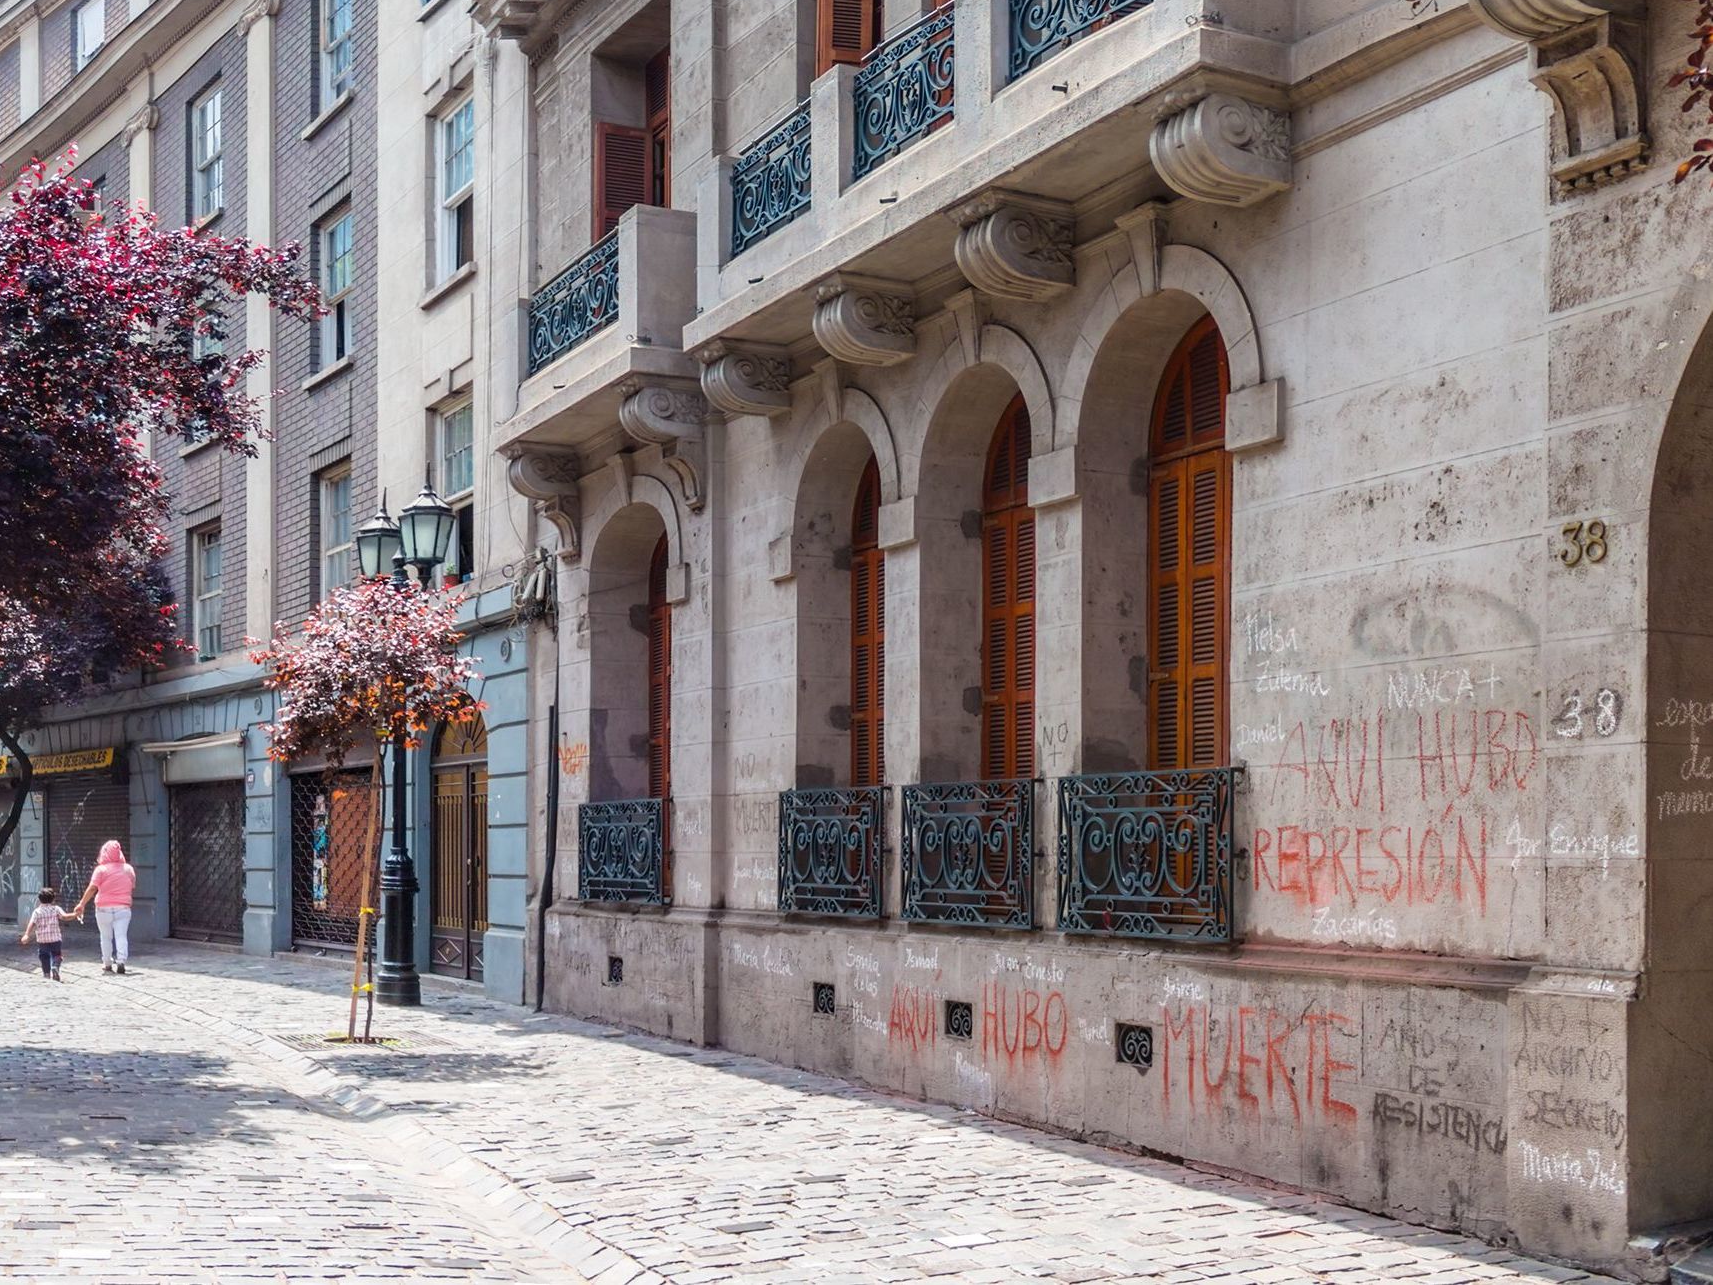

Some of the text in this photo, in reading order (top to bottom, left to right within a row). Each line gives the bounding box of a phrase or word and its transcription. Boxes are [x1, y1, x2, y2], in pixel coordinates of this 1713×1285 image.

[1562, 518, 1608, 567] 38
[1043, 723, 1068, 748] NO
[1416, 710, 1536, 800] HUBO
[1552, 688, 1621, 739] 38
[1252, 803, 1486, 913] REPRESIÓN
[982, 979, 1068, 1063] HUBO
[1161, 1005, 1358, 1127] MUERTE
